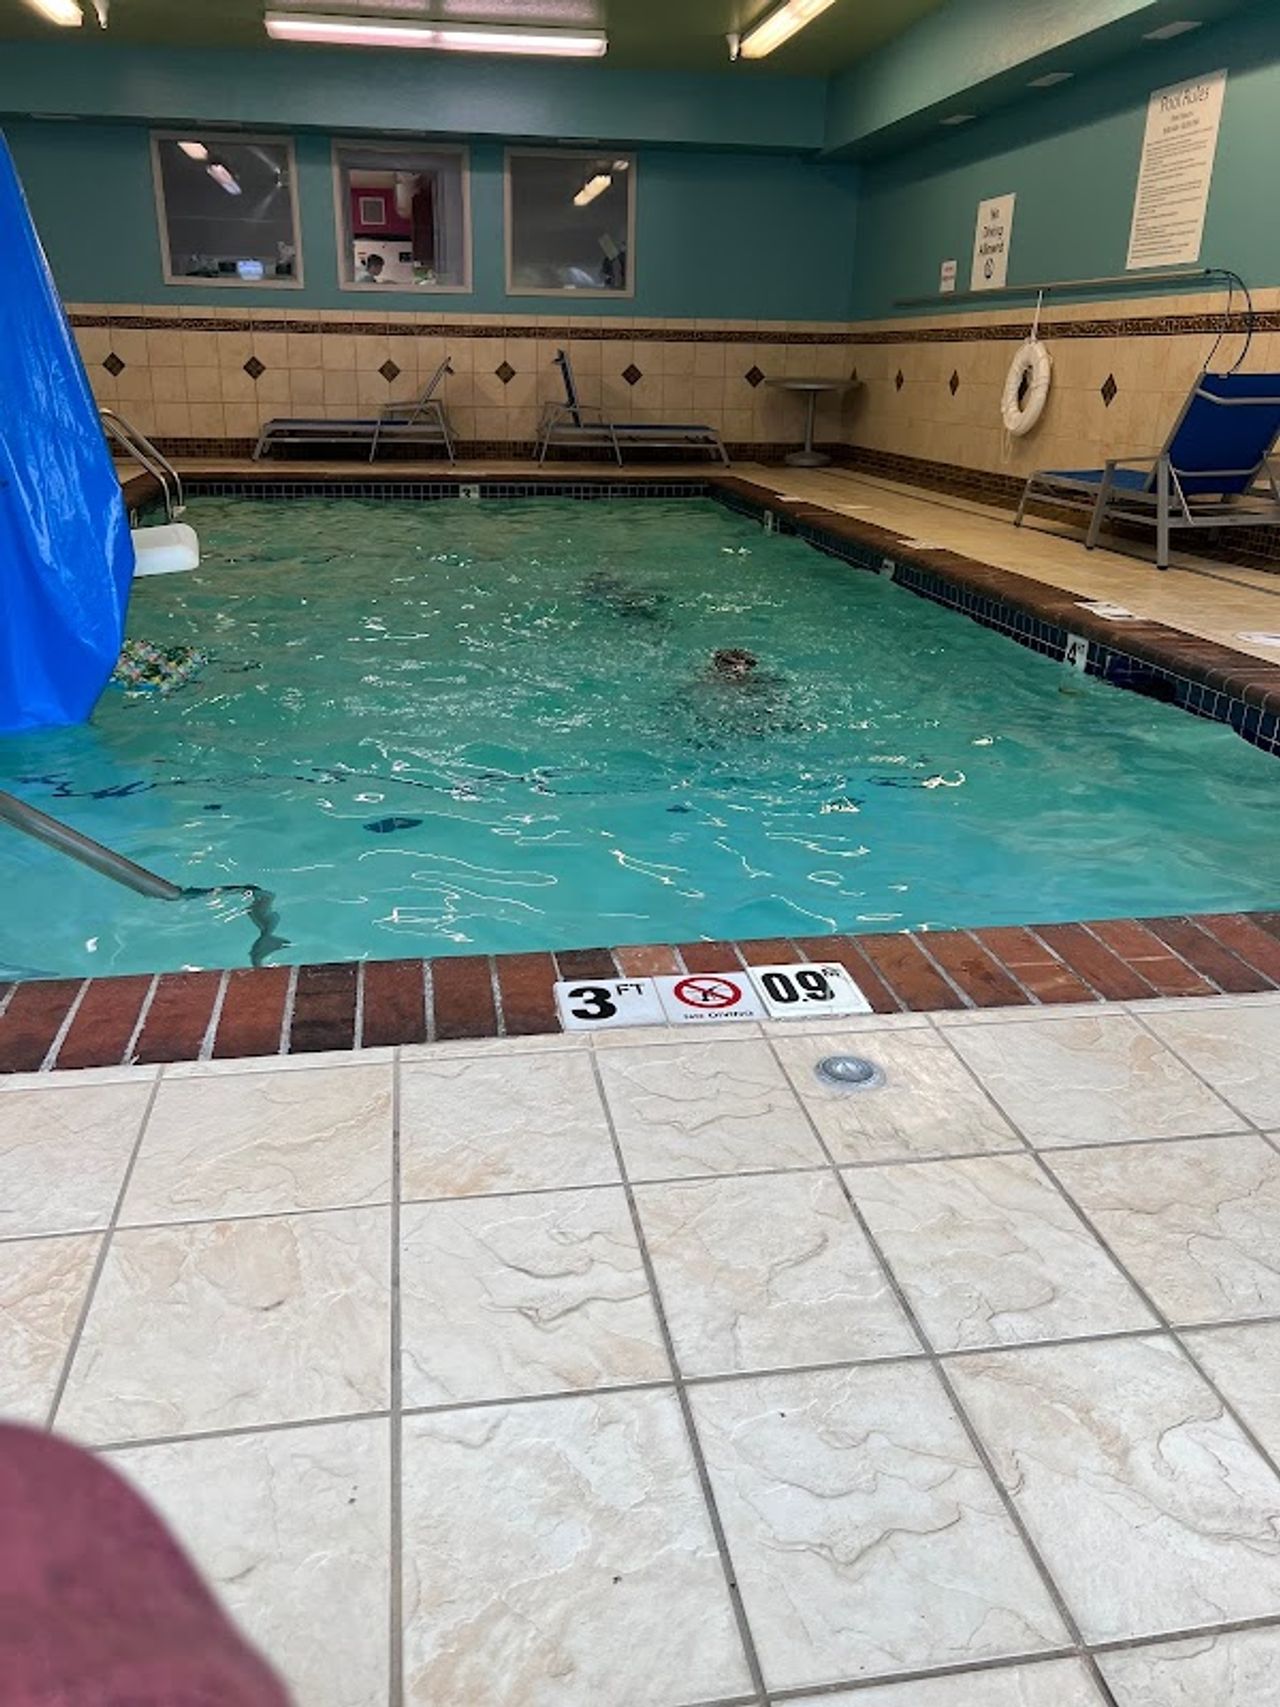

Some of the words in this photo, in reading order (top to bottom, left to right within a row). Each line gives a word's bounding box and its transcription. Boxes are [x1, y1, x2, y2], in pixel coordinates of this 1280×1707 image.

[1066, 641, 1077, 666] 4
[568, 986, 617, 1020] 3
[615, 983, 645, 996] FT
[761, 970, 836, 1004] 0.9
